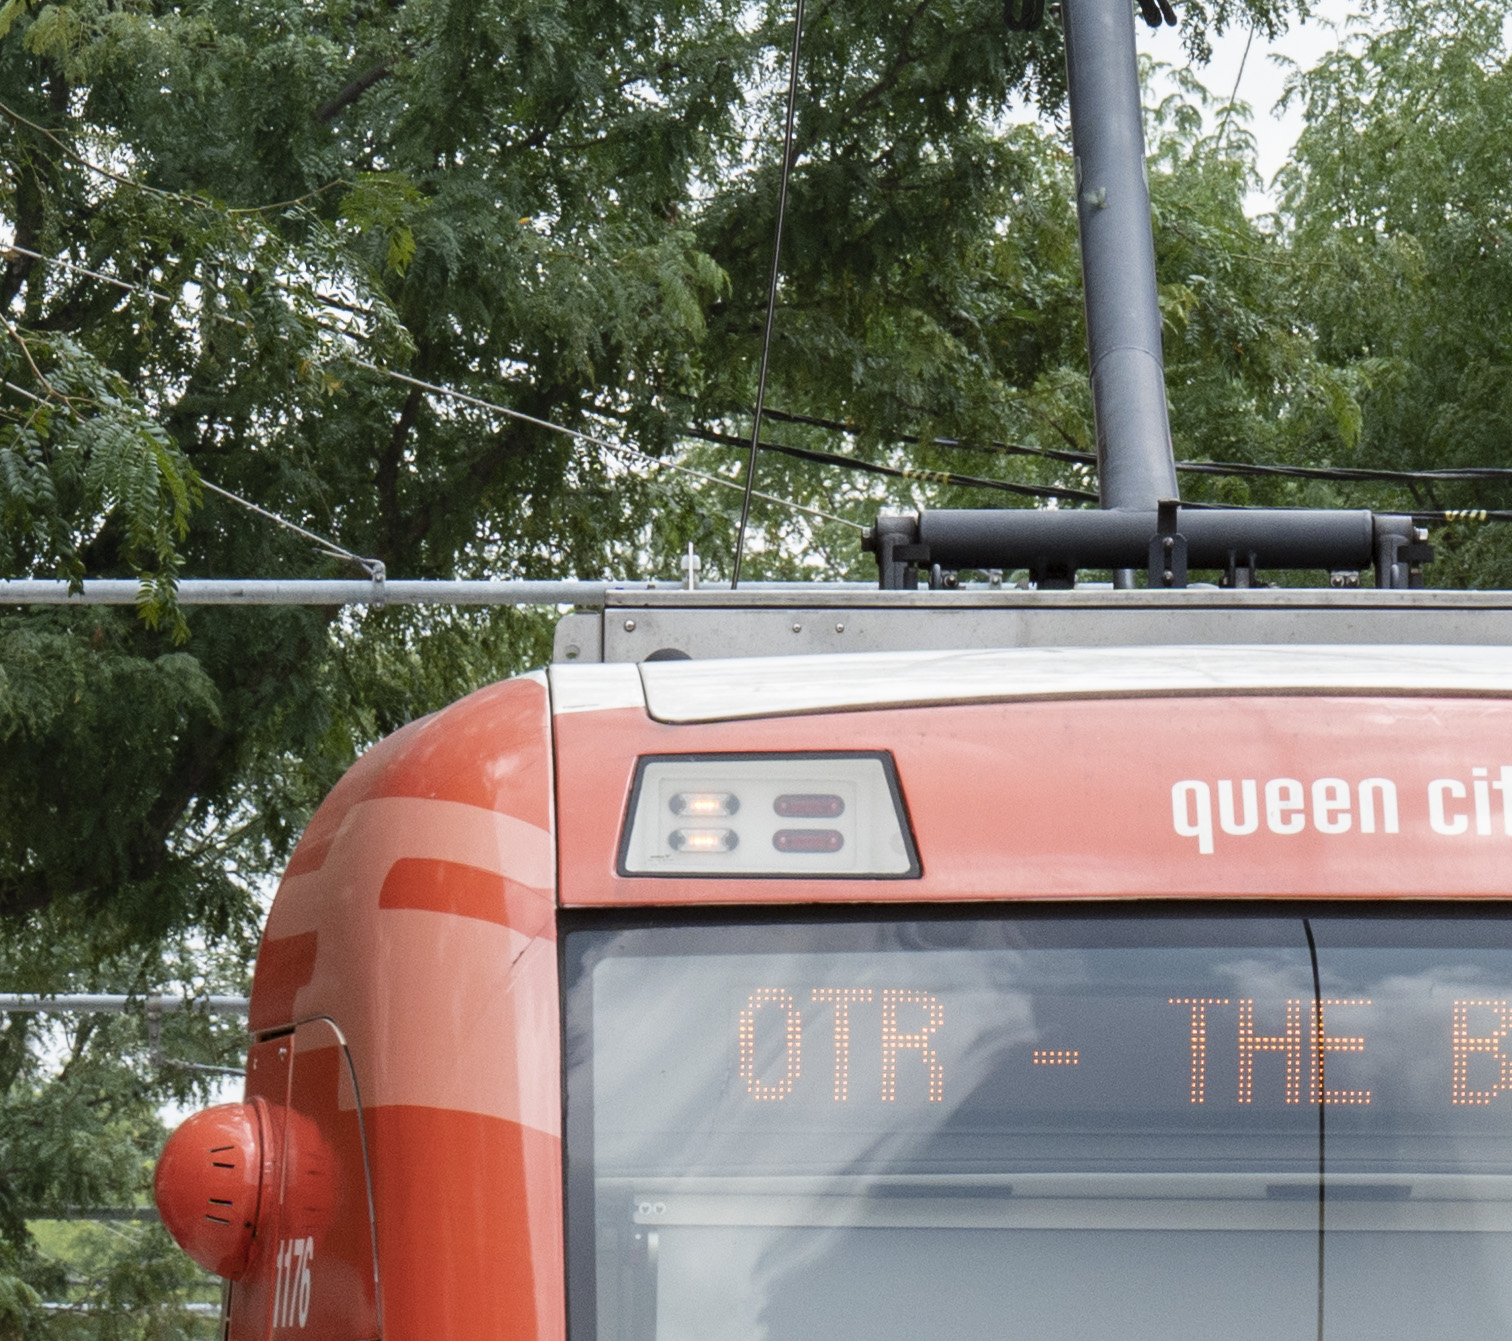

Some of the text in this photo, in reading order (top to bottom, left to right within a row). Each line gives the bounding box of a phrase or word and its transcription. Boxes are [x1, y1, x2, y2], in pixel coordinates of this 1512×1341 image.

[1172, 776, 1399, 854] queen
[738, 987, 946, 1106] OTR
[1168, 997, 1373, 1108] THE
[273, 1236, 314, 1328] 1176
